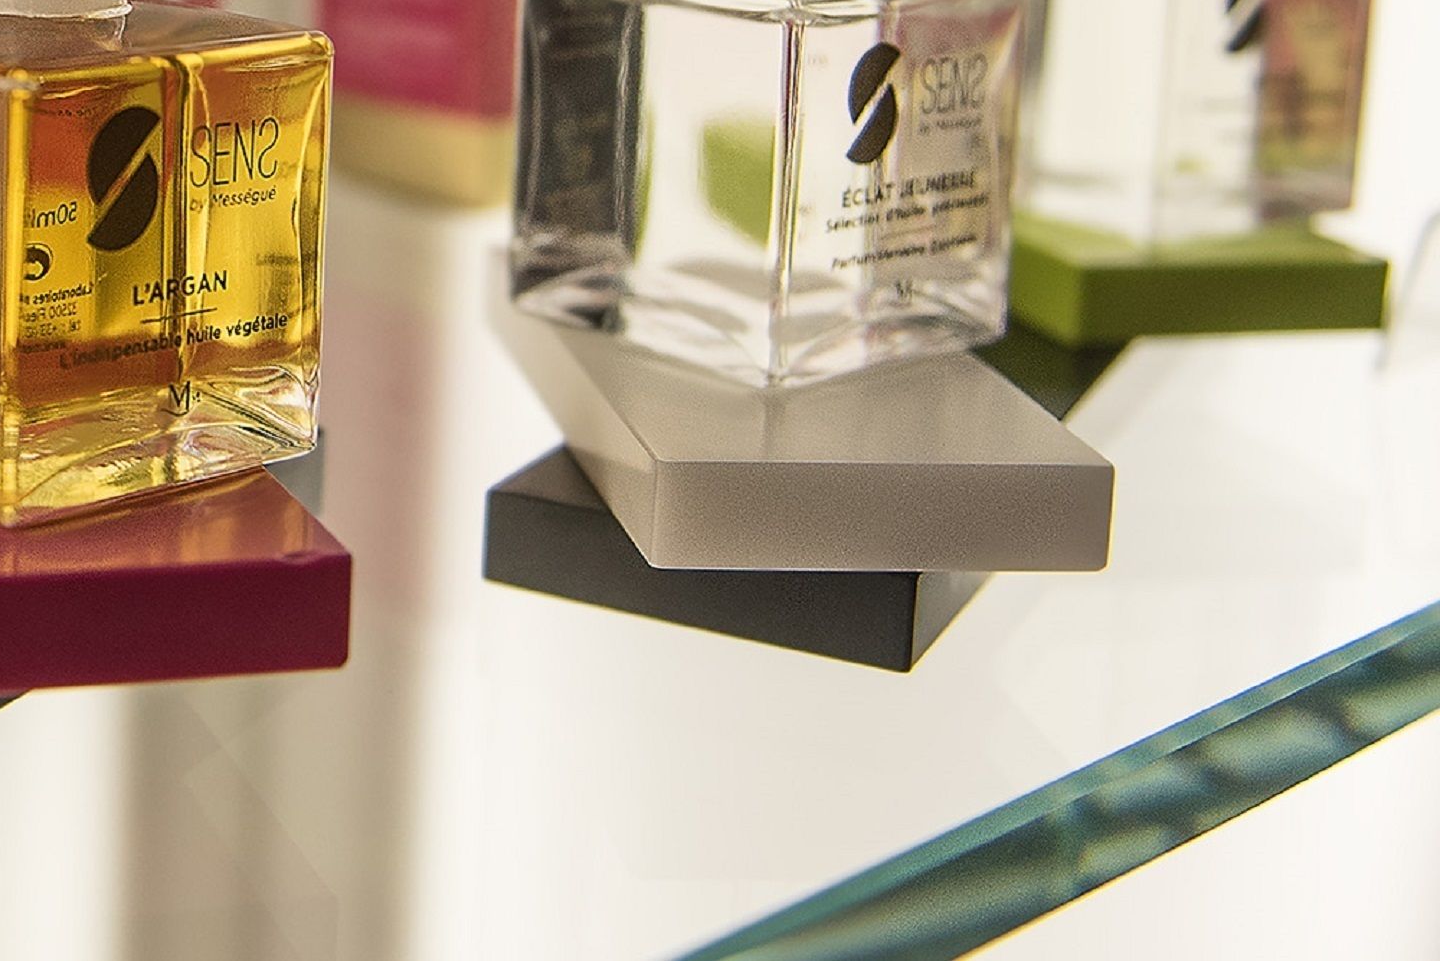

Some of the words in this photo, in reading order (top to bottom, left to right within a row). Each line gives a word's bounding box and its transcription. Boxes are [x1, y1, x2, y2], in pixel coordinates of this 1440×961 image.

[189, 116, 279, 188] SENS
[842, 182, 895, 208] ÉCLAT
[133, 270, 228, 306] L'ARGAN
[187, 324, 221, 346] huile
[226, 312, 289, 339] végétale
